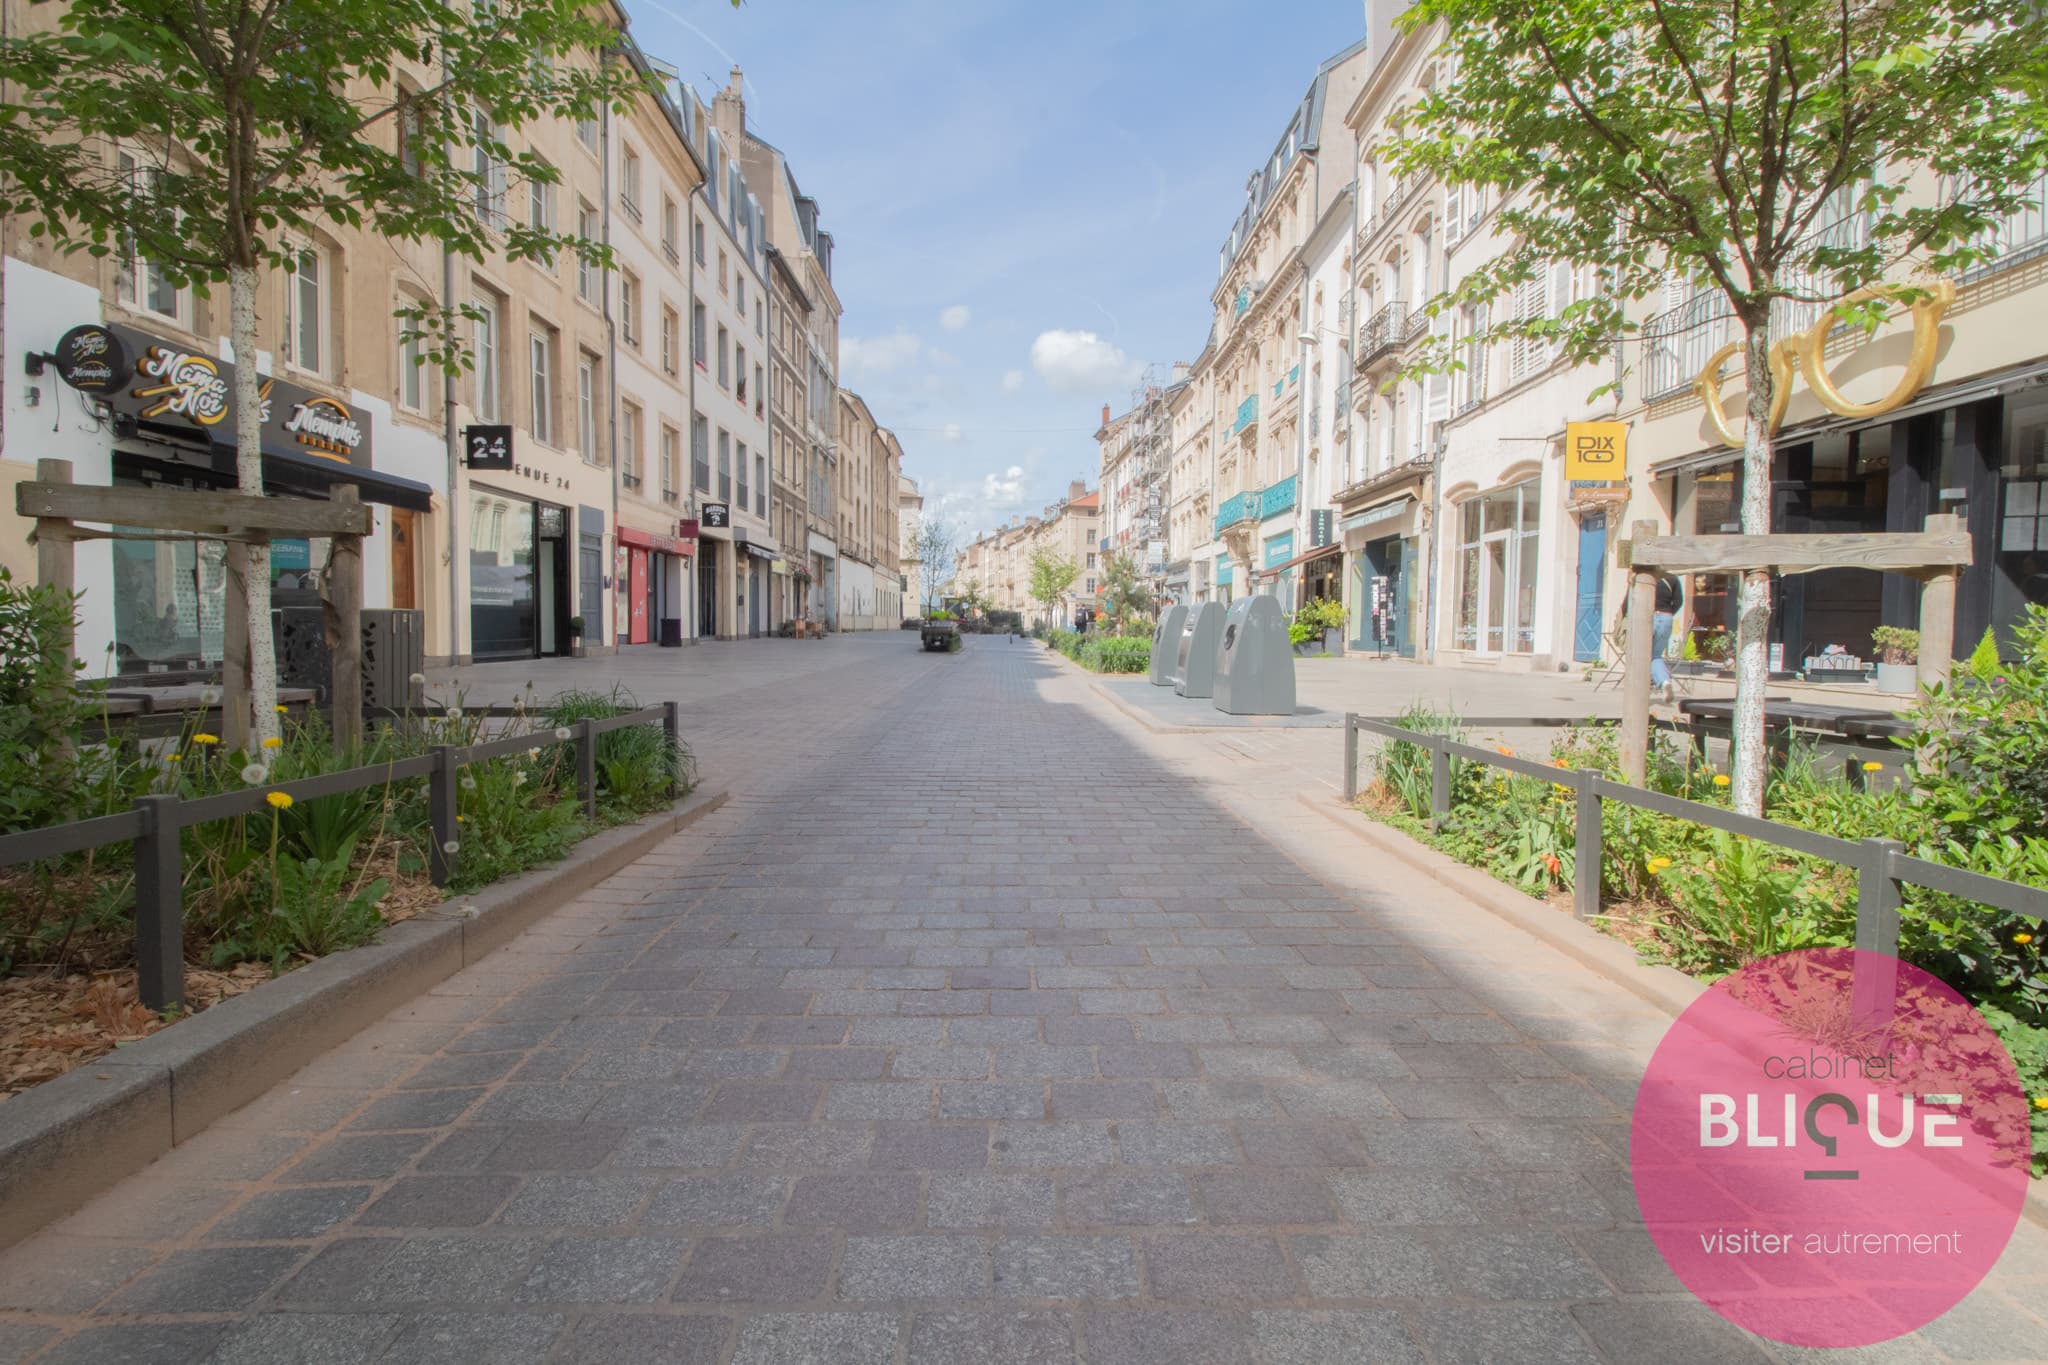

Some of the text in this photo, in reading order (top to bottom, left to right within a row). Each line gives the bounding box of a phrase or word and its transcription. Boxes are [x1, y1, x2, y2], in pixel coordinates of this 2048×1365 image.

[146, 348, 228, 394] Mama
[285, 403, 362, 448] Memphis
[472, 436, 506, 458] 24
[1577, 436, 1615, 449] DIX
[514, 464, 550, 483] ENUE
